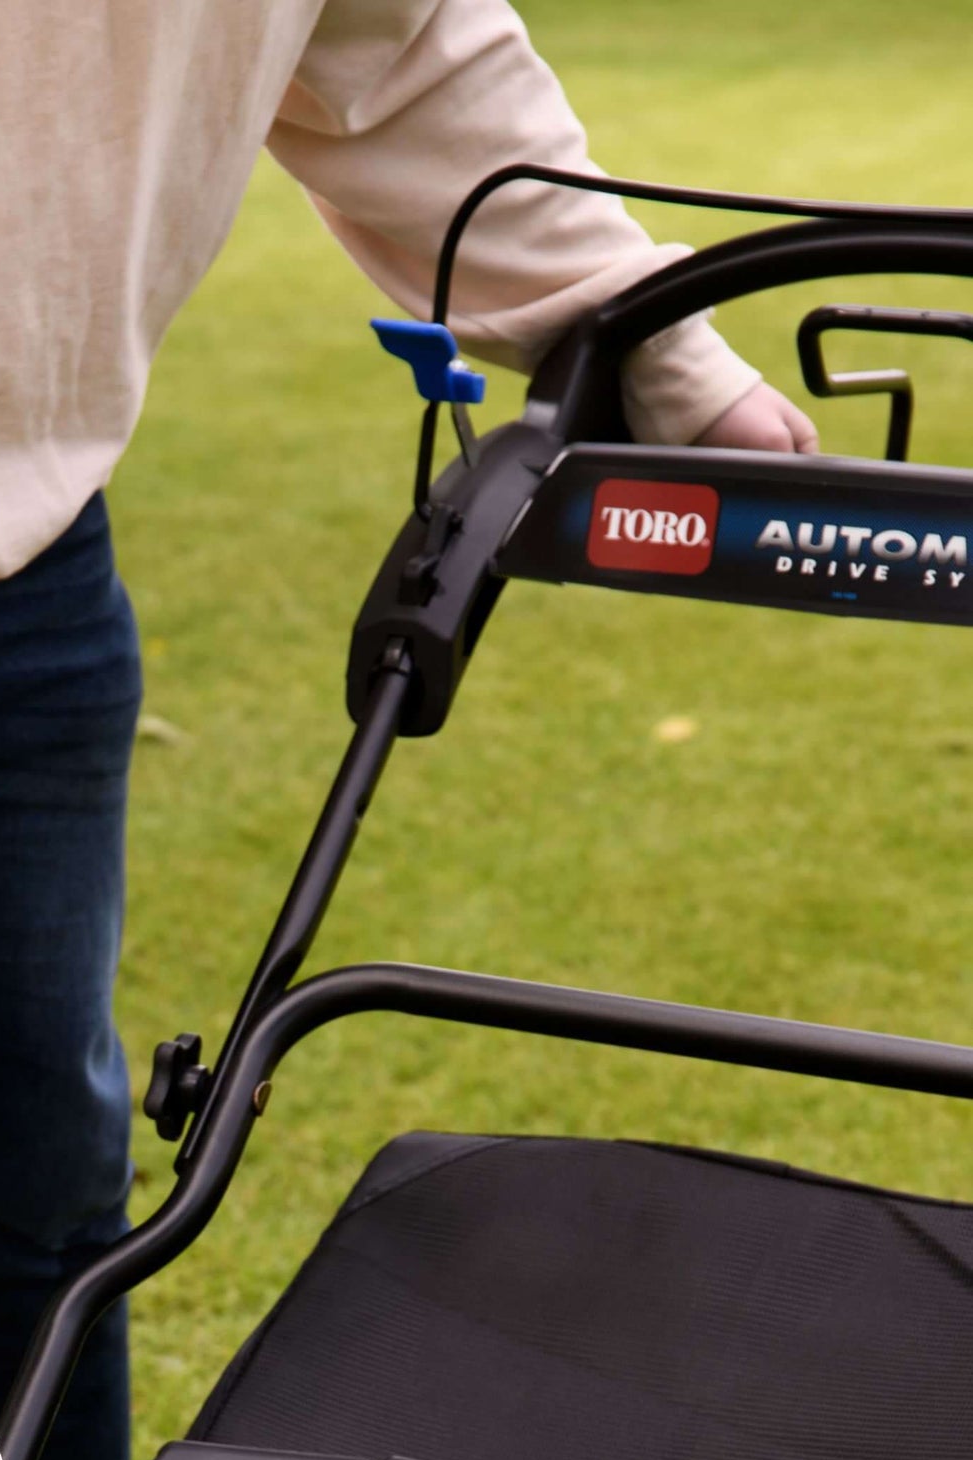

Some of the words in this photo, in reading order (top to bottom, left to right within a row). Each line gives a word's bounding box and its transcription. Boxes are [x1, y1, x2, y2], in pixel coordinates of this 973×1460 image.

[600, 505, 708, 547] TORO
[755, 519, 968, 567] AUTOM
[775, 556, 891, 582] DRIVE
[922, 568, 967, 588] SY
